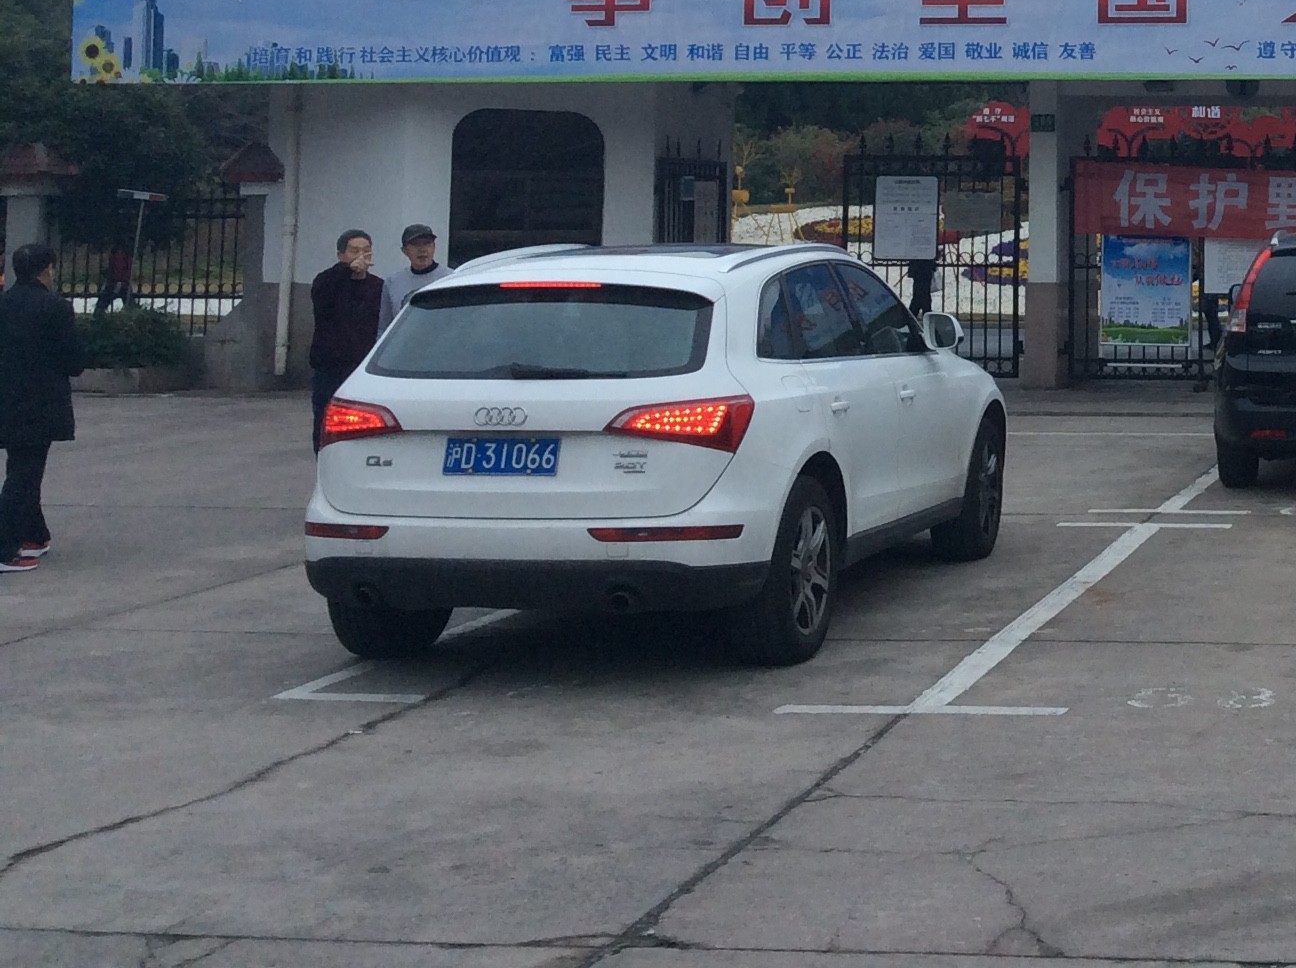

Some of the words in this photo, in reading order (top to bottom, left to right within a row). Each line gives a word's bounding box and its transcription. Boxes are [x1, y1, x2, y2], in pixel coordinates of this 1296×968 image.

[549, 44, 584, 63] 富强
[594, 44, 631, 62] 民主
[641, 44, 677, 62] 文明
[686, 43, 723, 62] 和谐
[733, 42, 770, 61] 自由
[780, 42, 817, 61] 平等
[826, 42, 863, 61] 公正
[872, 42, 909, 61] 法治
[918, 42, 956, 60] 爱国
[965, 42, 1003, 60] 敬业
[1012, 42, 1049, 60] 诚信
[1058, 42, 1097, 60] 友善
